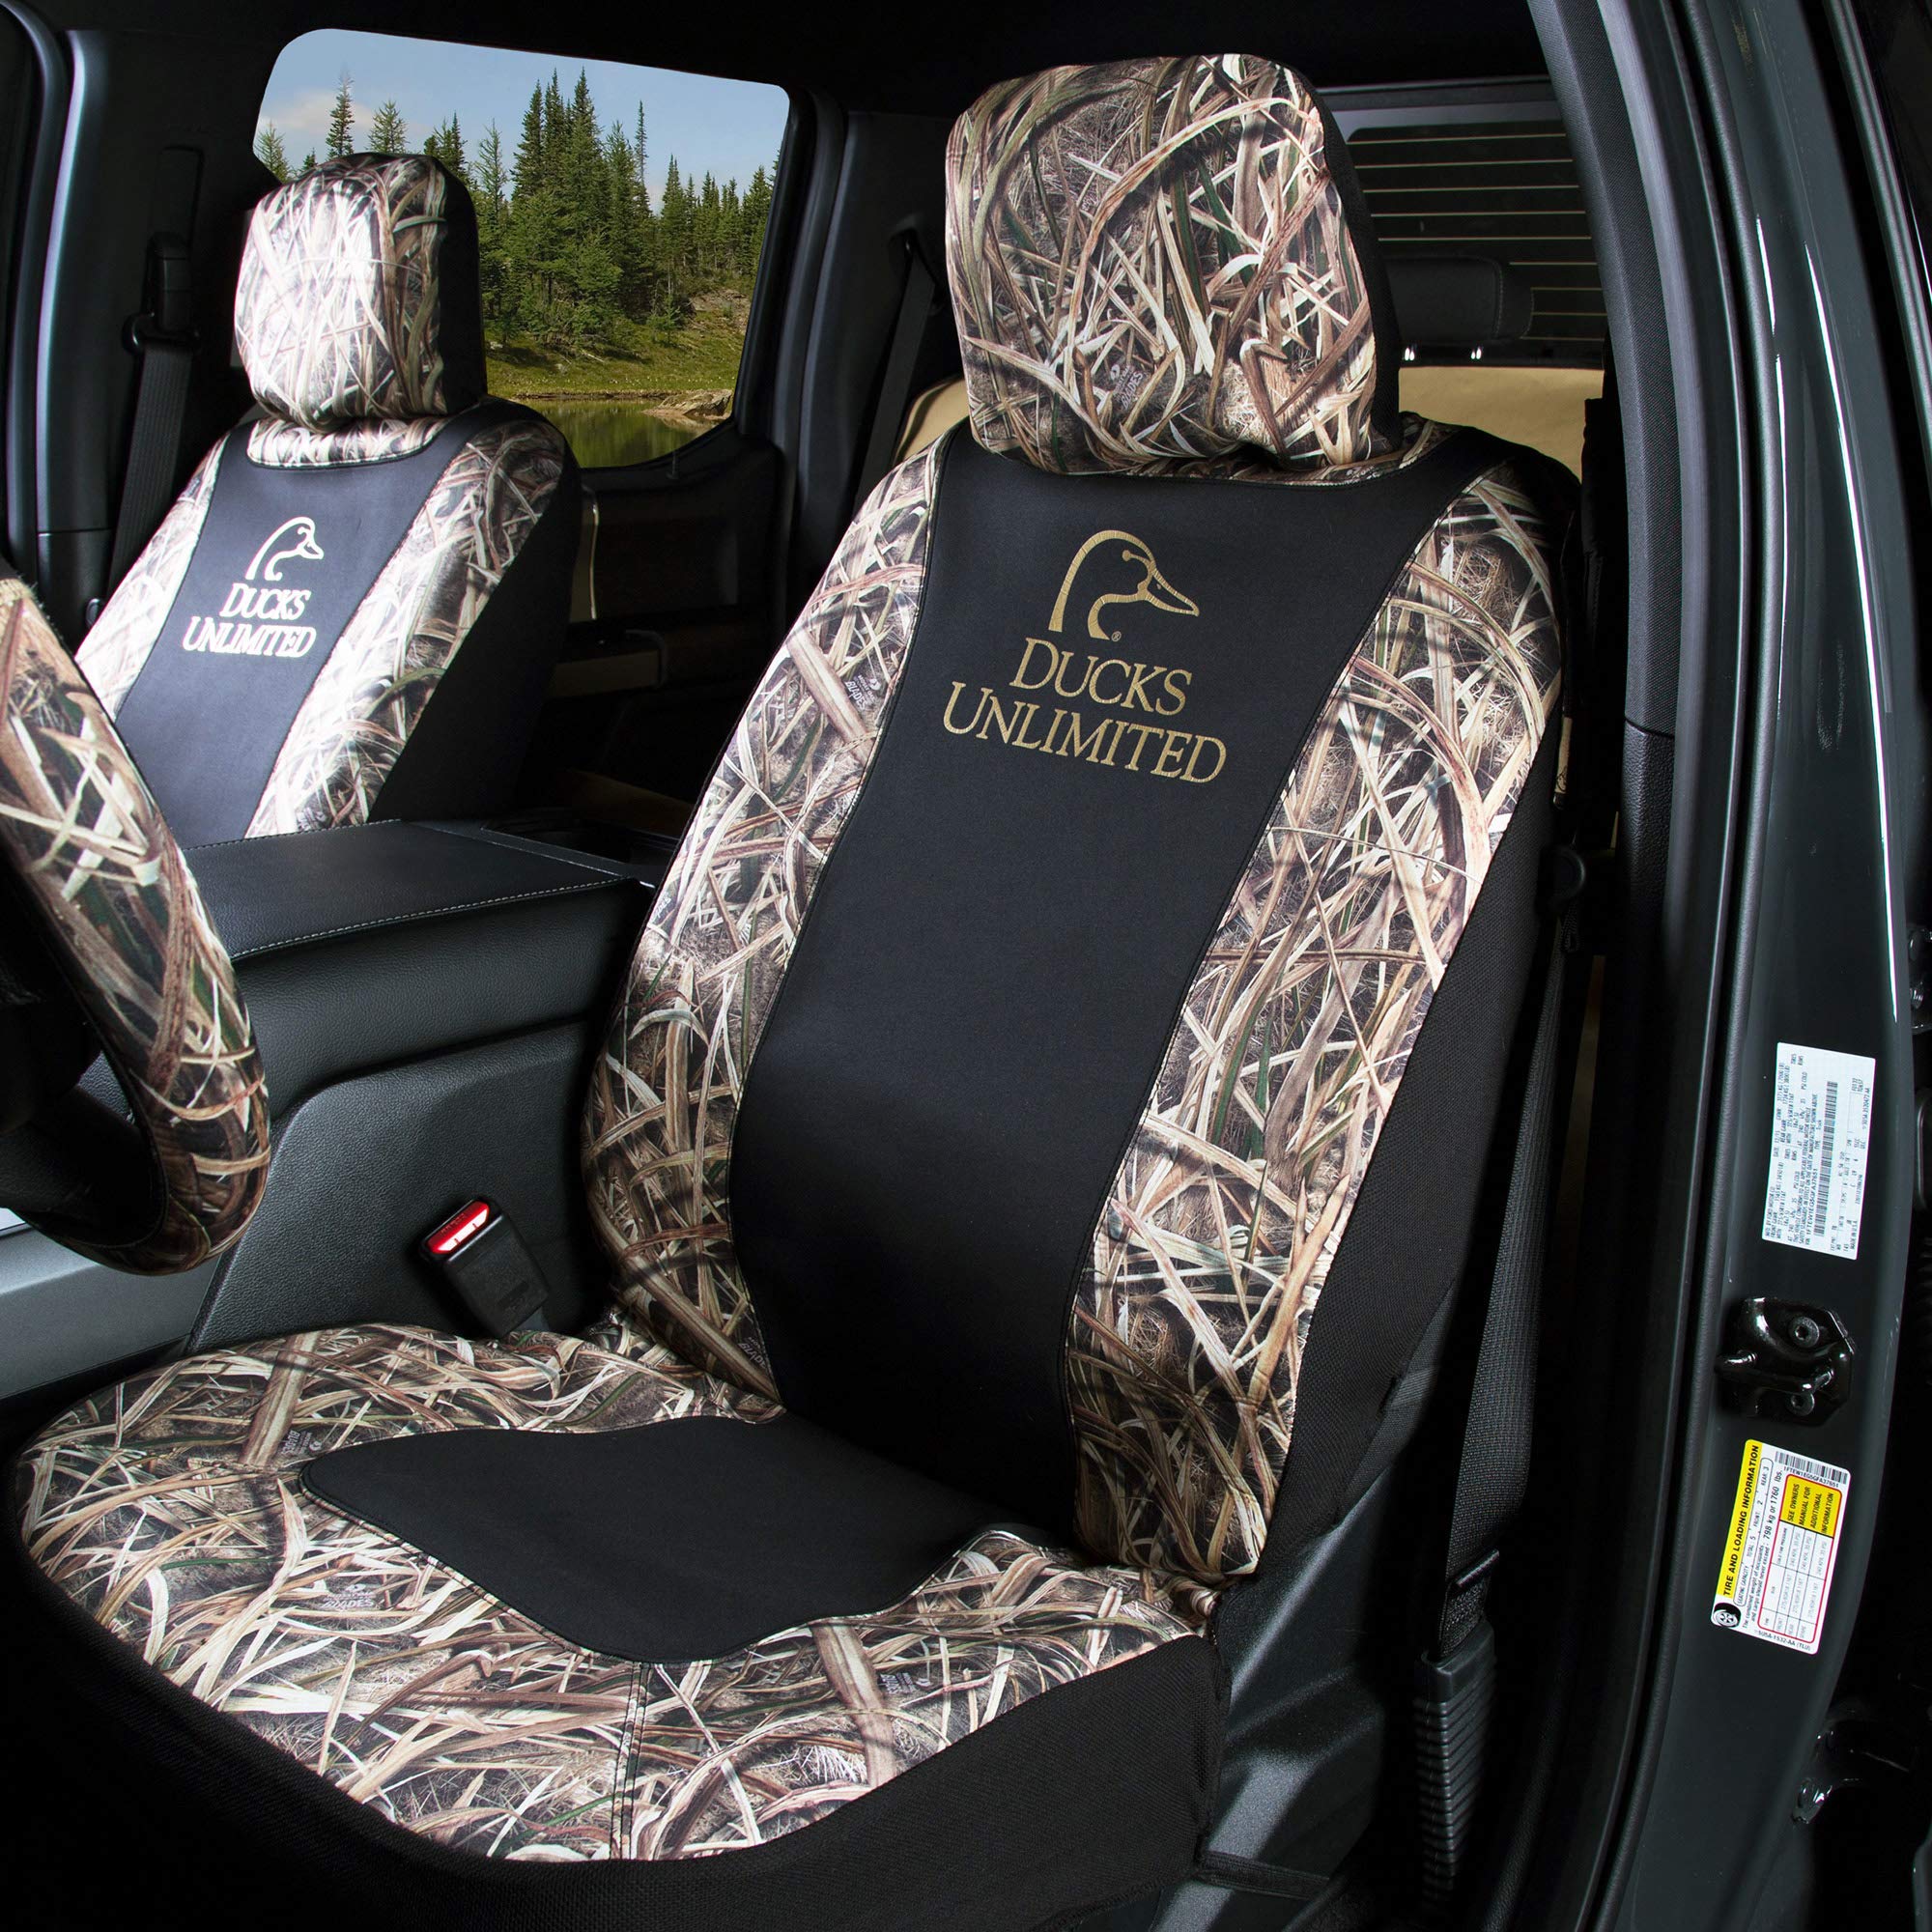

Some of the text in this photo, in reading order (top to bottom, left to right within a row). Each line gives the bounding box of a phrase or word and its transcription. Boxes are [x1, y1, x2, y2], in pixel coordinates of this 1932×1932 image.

[219, 582, 311, 620] DUCKS
[183, 616, 317, 658] UNLIMITED
[1009, 638, 1193, 716] DUCKS
[943, 681, 1227, 783] UNLIMITED
[1770, 1486, 1780, 1505] 1760
[1770, 1505, 1776, 1514] or
[1789, 1484, 1800, 1509] OWNERS
[1799, 1500, 1808, 1525] MANUAL
[1810, 1492, 1822, 1528] ADDITIONAL
[1821, 1492, 1834, 1534] INFORMATION
[1723, 1445, 1759, 1596] TIRE AND LOADING INFORMATION
[1763, 1524, 1773, 1540] 798
[1766, 1514, 1776, 1524] kg
